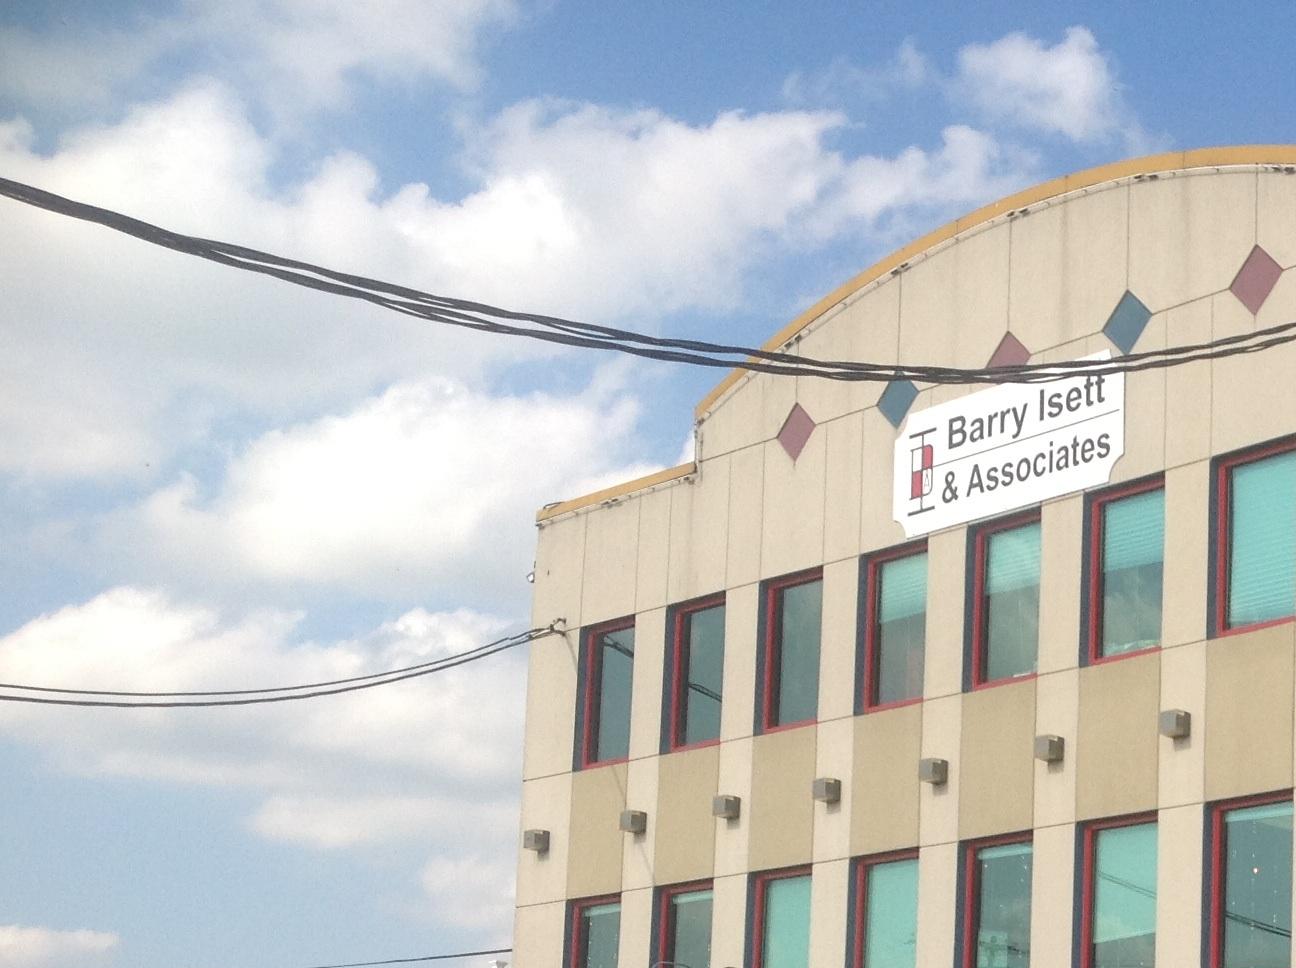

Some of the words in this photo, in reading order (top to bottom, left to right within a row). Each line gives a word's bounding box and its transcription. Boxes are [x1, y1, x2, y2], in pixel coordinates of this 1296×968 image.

[948, 403, 1028, 449] Barry
[1039, 375, 1106, 421] Isett
[941, 471, 959, 503] &
[966, 432, 1112, 497] Associates
